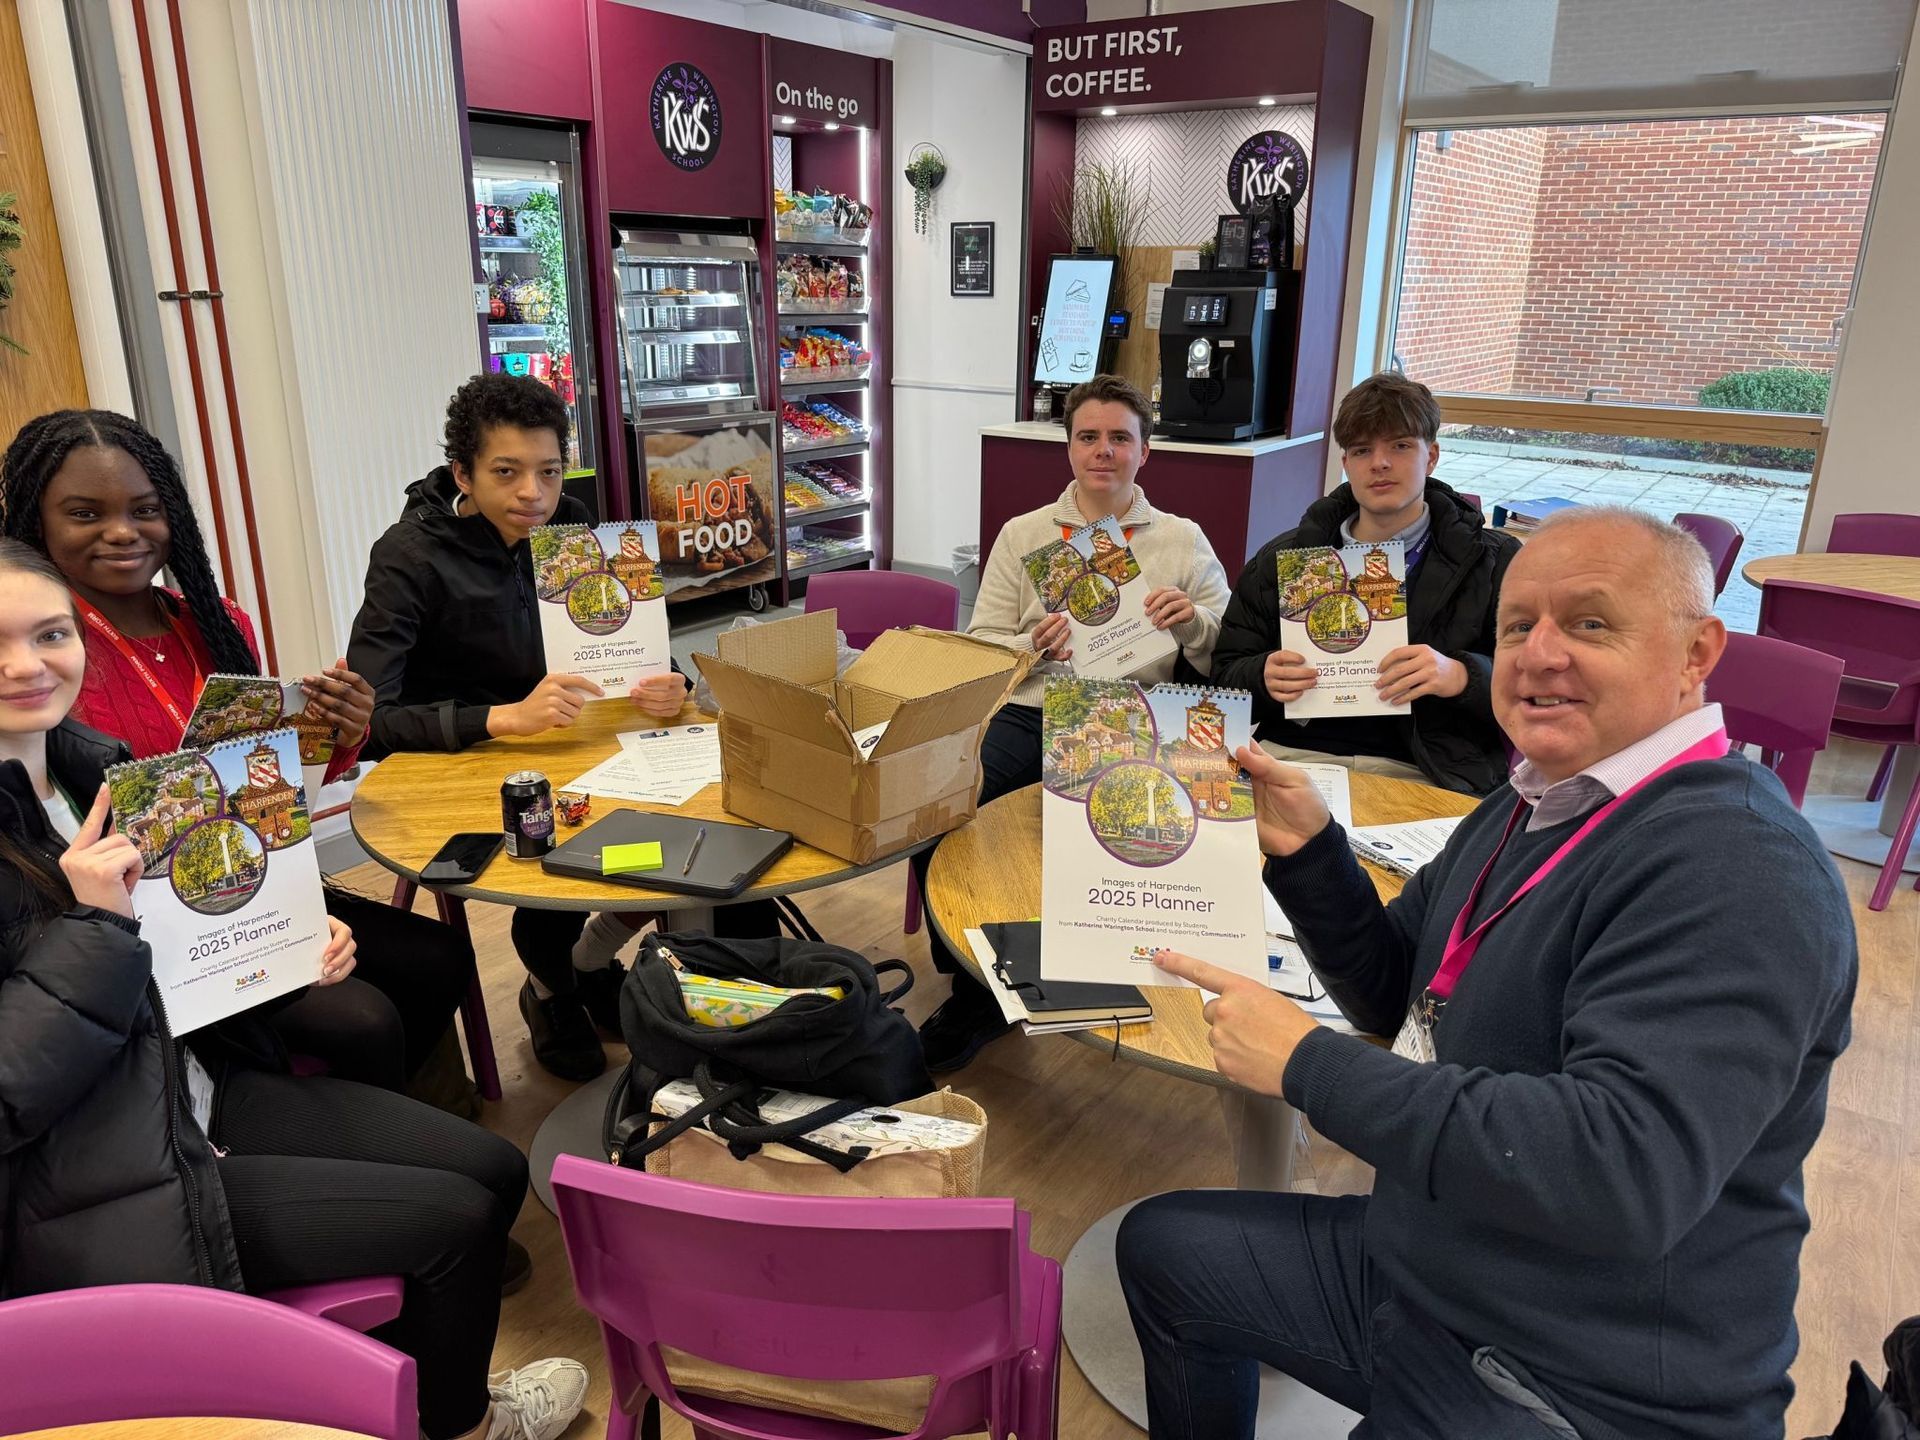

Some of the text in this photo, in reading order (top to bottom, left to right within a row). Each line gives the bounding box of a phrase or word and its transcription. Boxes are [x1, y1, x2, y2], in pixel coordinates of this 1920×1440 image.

[1047, 26, 1182, 62] BUT FIRST,
[1045, 67, 1152, 98] COFFEE.
[653, 70, 719, 136] KATHERINE WARINGTON
[776, 81, 859, 119] On the go
[672, 152, 705, 168] SCHOOL
[1231, 136, 1305, 191] KATHERINE WARINGTON
[675, 474, 752, 523] HOT
[678, 518, 753, 558] FOOD
[87, 611, 120, 641] SIXTH FORM
[1088, 636, 1110, 652] 2025
[1109, 621, 1141, 641] Planner
[573, 647, 645, 661] 2025 Planner
[130, 654, 158, 688] SIXTH FORM
[1316, 667, 1336, 677] 025
[166, 703, 181, 720] FORM
[240, 788, 296, 812] HARPENDEN
[1088, 888, 1215, 913] 2025 Planner
[1101, 877, 1202, 893] Images of Harpenden
[197, 909, 280, 942] Images of Harpenden
[1073, 921, 1103, 930] Katherine
[1103, 923, 1134, 932] Warington
[1135, 925, 1155, 933] School
[1168, 928, 1200, 938] supporting
[1200, 930, 1240, 940] Communities
[1096, 915, 1209, 930] Charity Calendar produced by Students
[188, 917, 292, 962] 2025 Planner
[183, 974, 208, 987] Katherine
[207, 964, 233, 977] Warington
[233, 958, 250, 969] School
[284, 936, 313, 949] Communities
[218, 956, 240, 967] Calendar
